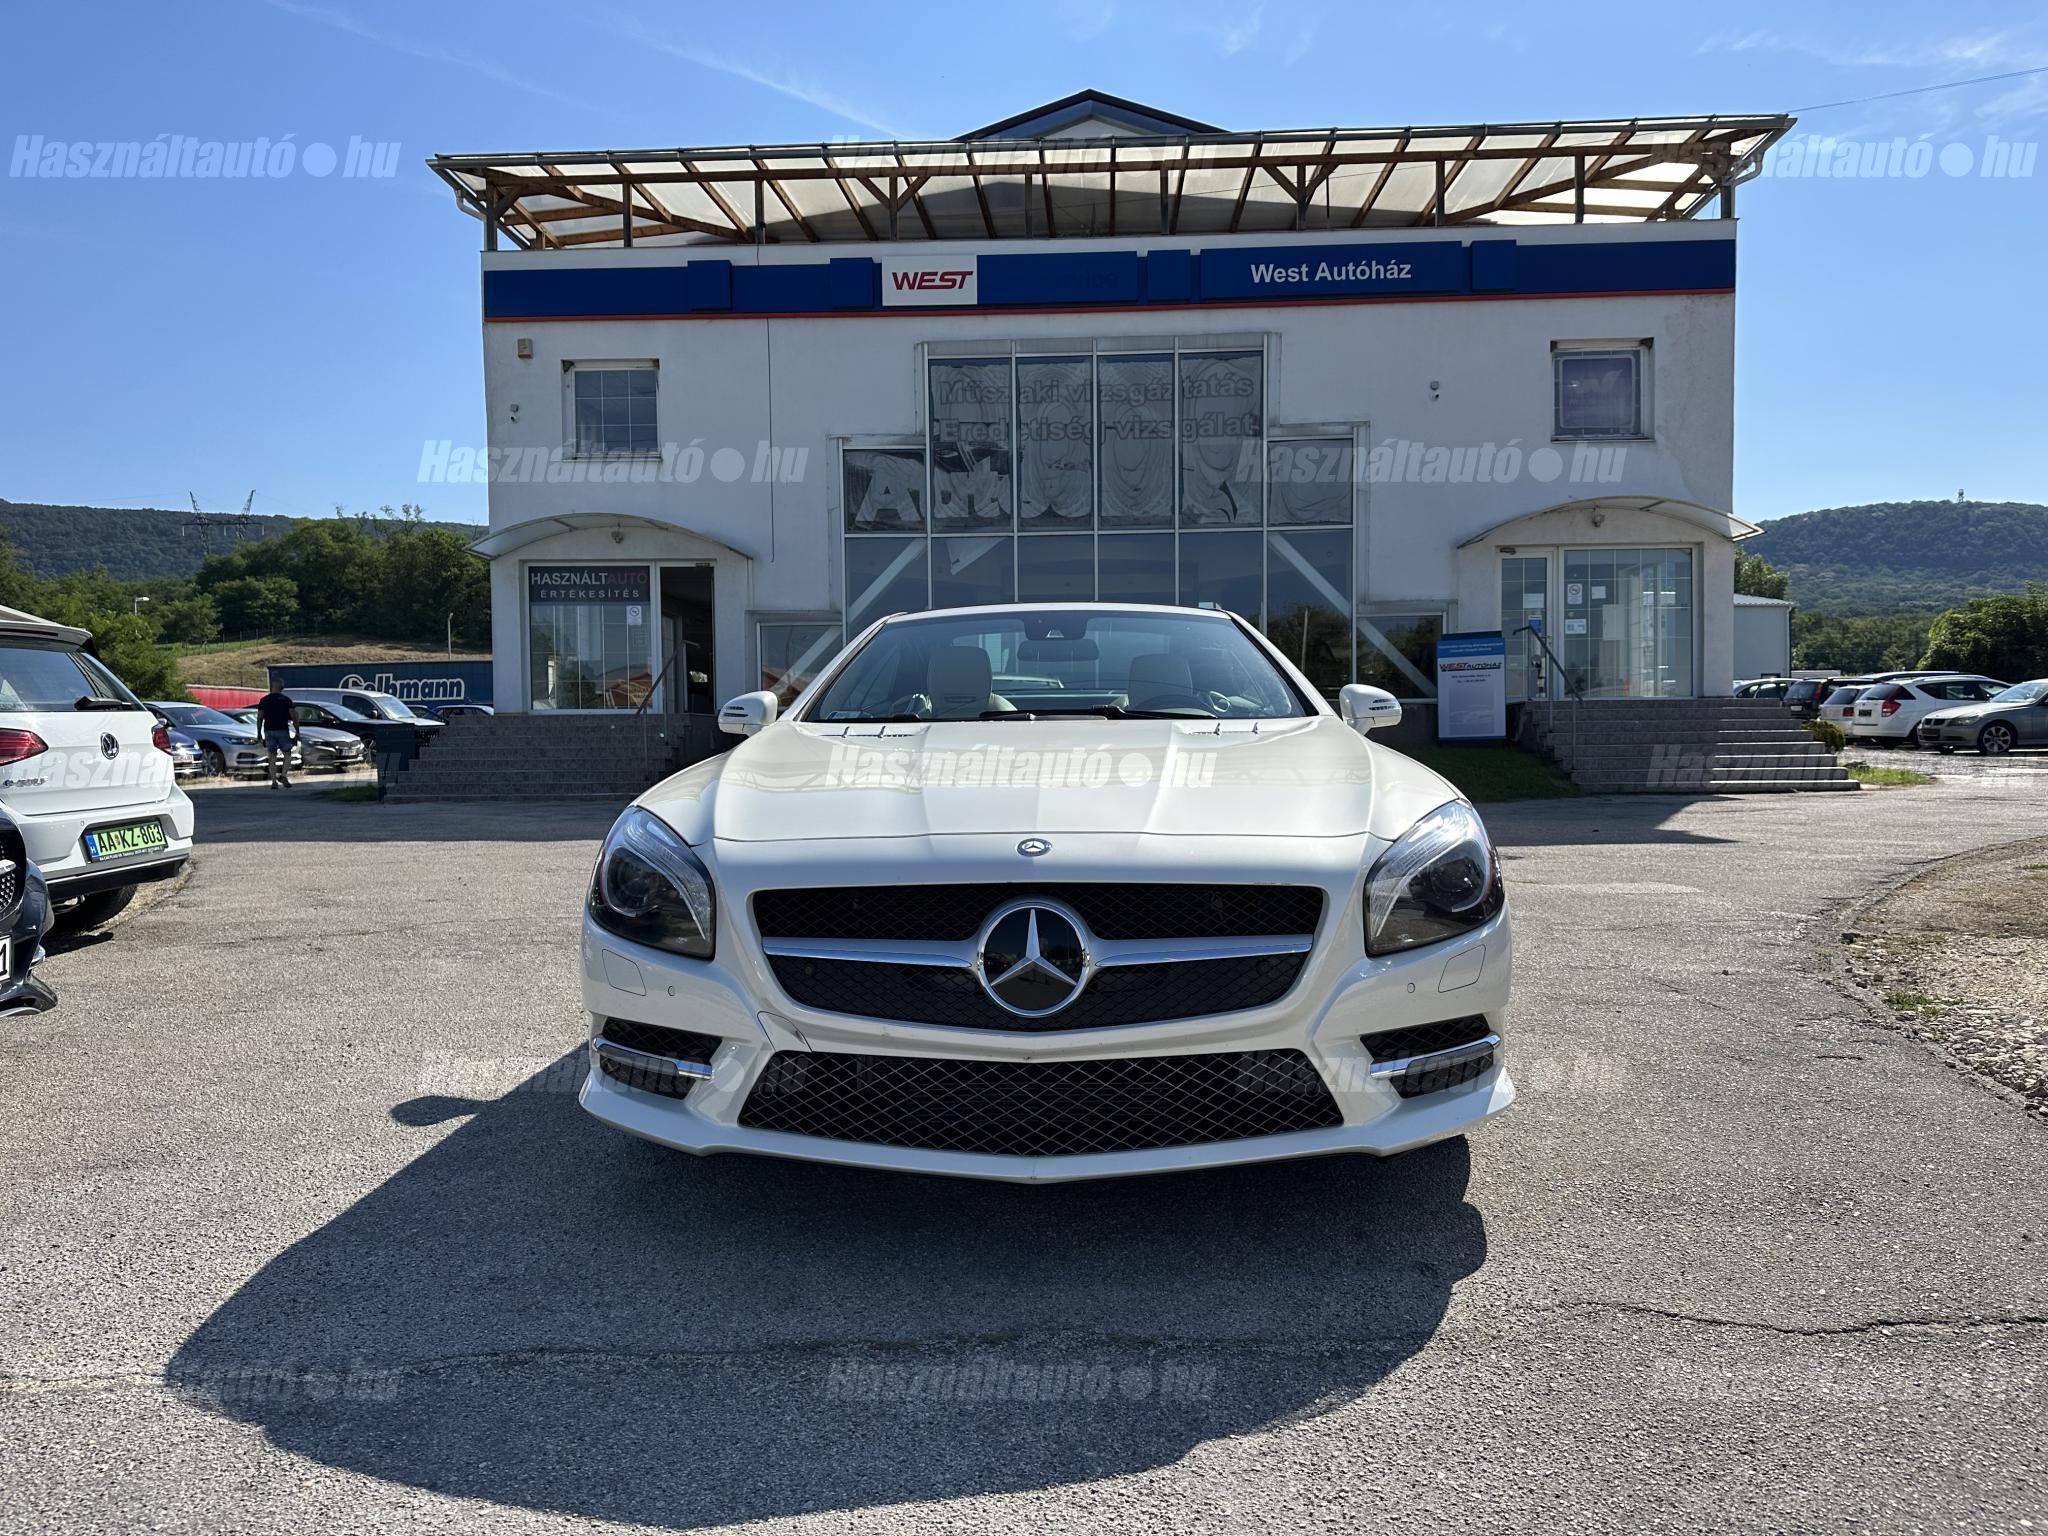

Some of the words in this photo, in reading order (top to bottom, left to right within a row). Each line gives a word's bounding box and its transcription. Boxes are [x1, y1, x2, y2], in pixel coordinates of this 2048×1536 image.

[891, 271, 974, 290] WEST
[1250, 263, 1309, 283] West
[1314, 259, 1412, 281] Autóház
[540, 588, 640, 598] ÉRTÉKESÍTÉS
[99, 833, 116, 852] AA
